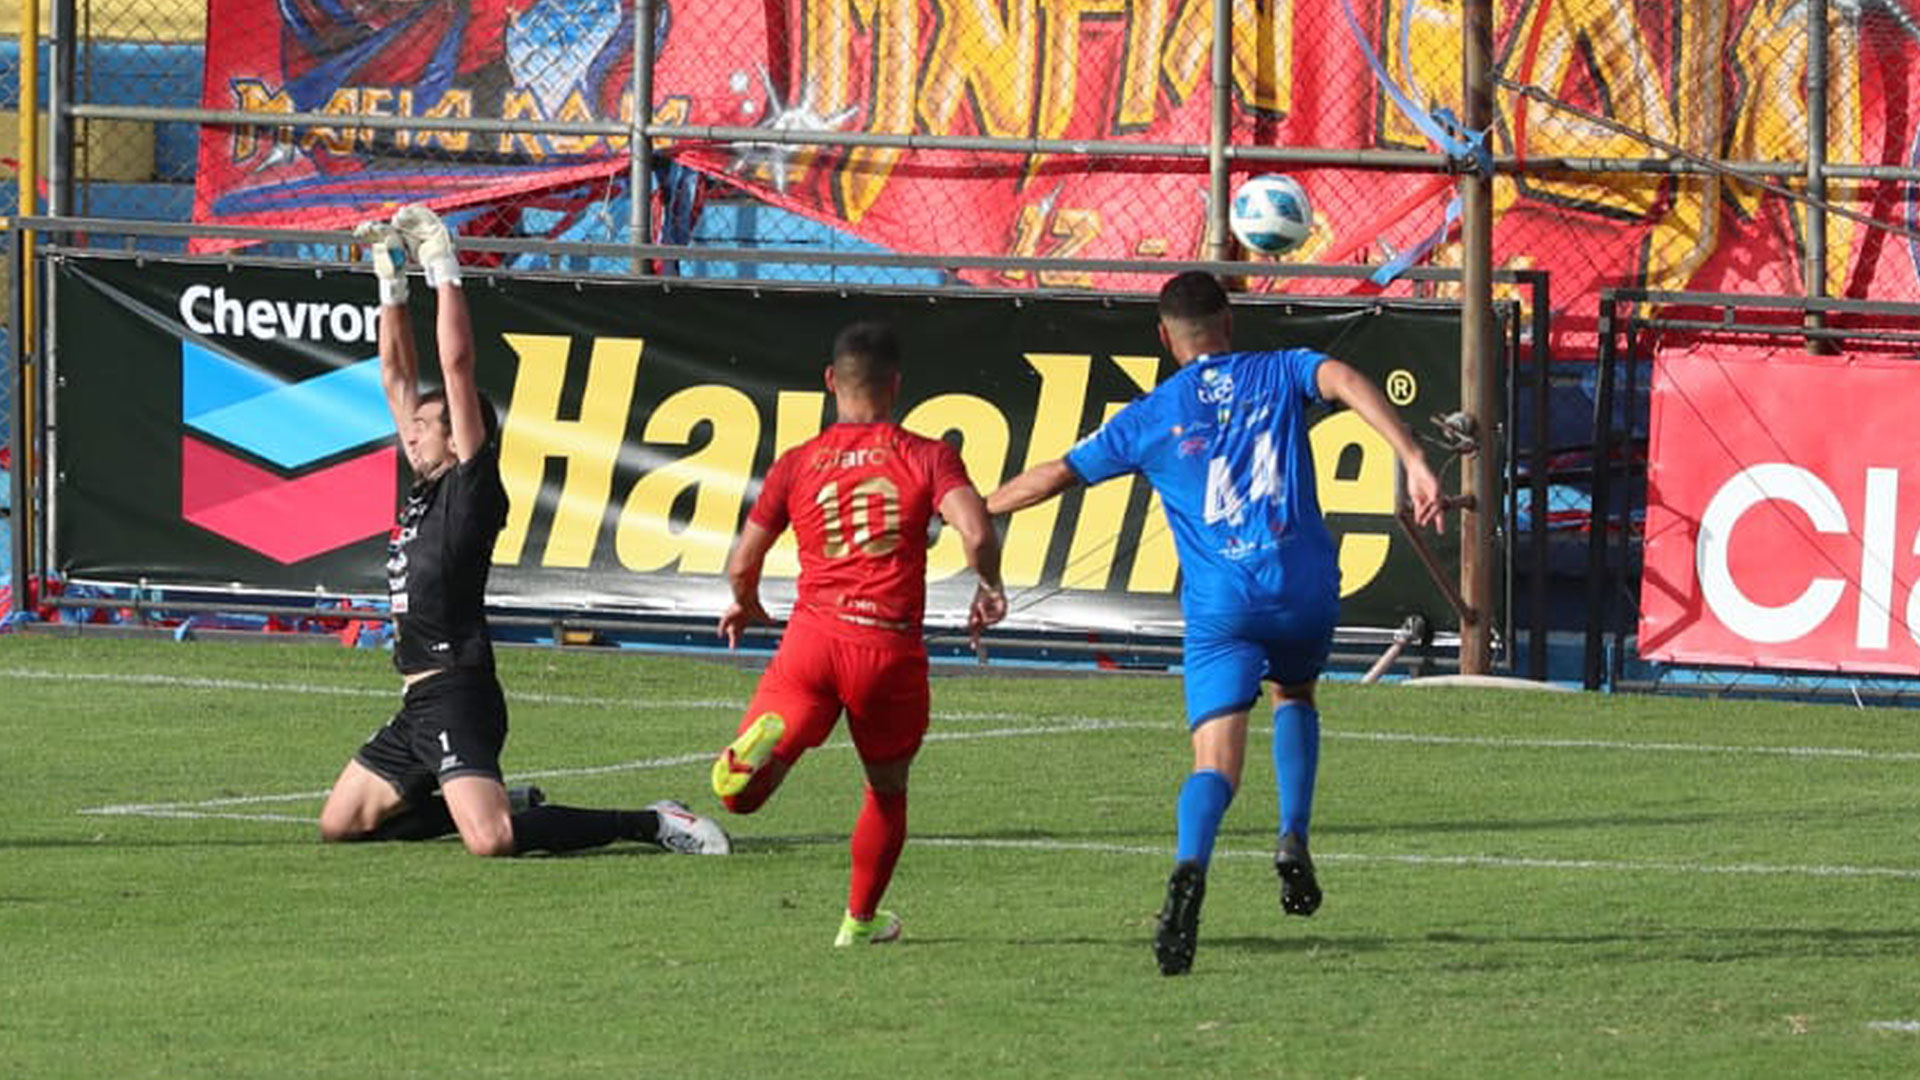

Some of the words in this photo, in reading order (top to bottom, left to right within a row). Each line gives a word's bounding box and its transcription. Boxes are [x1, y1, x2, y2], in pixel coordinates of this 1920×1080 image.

[816, 476, 900, 558] 10
[1203, 431, 1279, 526] 44
[1696, 463, 1920, 650] Cl
[438, 731, 451, 751] 1
